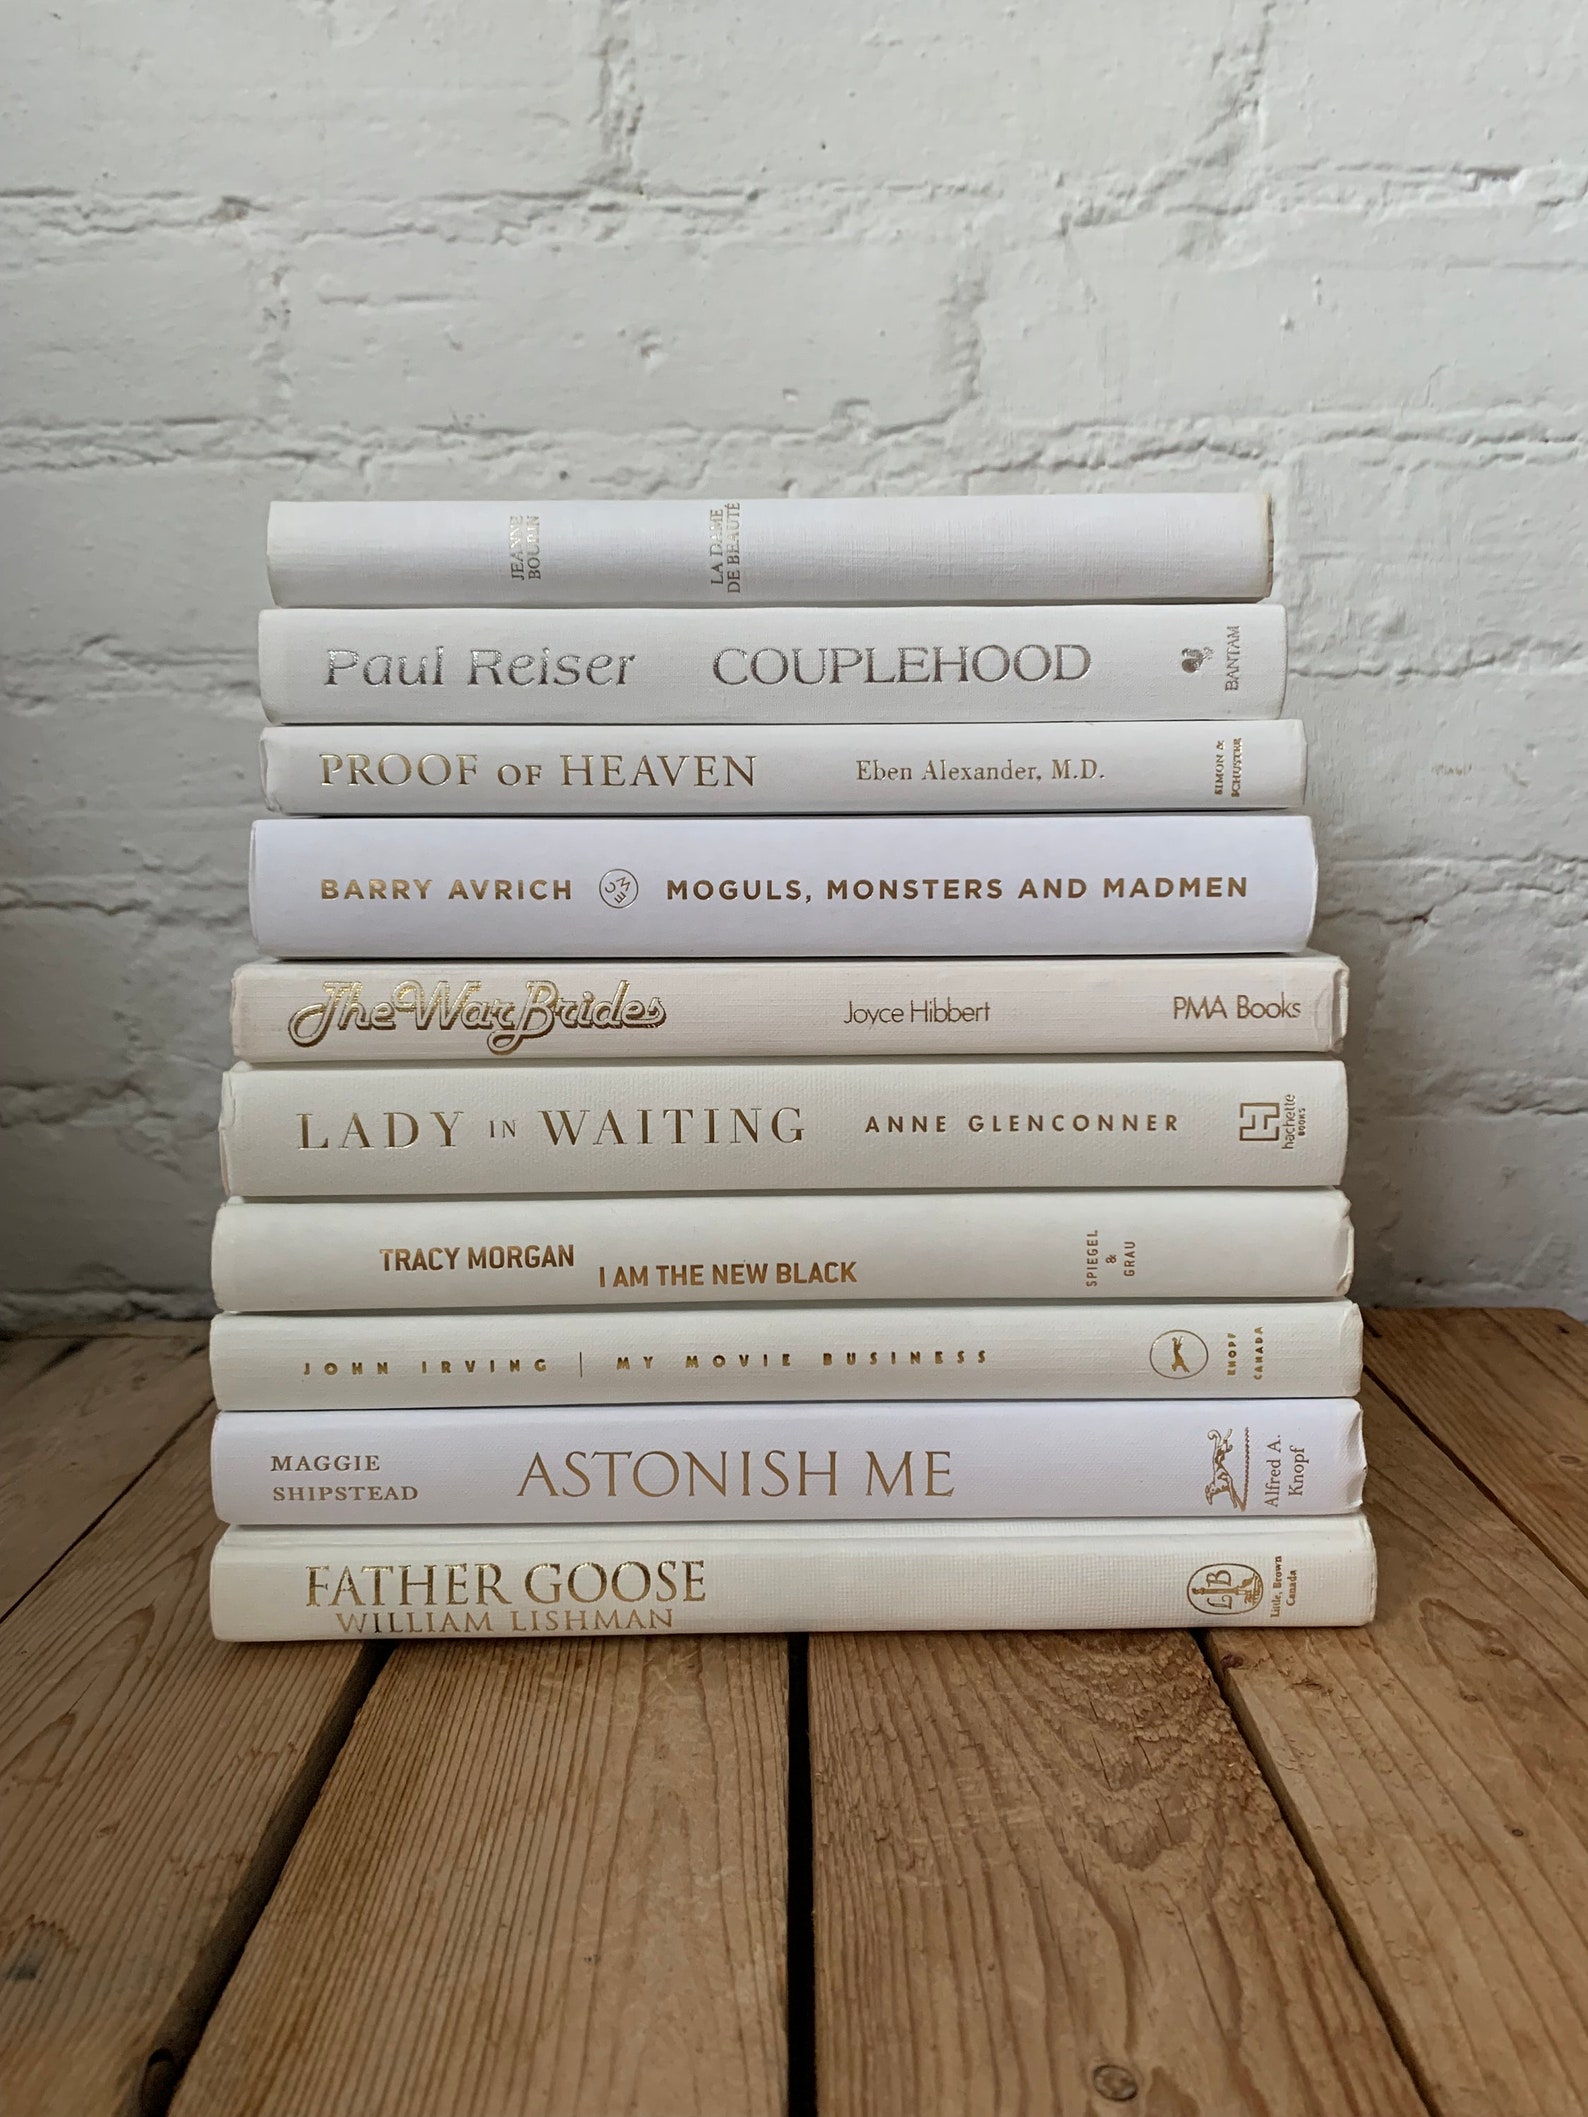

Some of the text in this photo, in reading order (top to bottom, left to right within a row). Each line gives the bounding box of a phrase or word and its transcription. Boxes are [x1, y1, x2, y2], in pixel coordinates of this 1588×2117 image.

[510, 514, 525, 581] JEANNE
[710, 508, 723, 585] LA DAME
[724, 502, 741, 593] DE BEAUTÉ
[324, 645, 637, 687] Paul Reiser
[713, 643, 1093, 686] COUPLEHOOD
[1225, 625, 1241, 691] BANTAM
[319, 753, 478, 787] PROOF
[560, 755, 756, 787] HEAVEN
[856, 758, 1105, 783] Eben Alexander, M.D.
[1214, 739, 1225, 797] SIMON &
[1231, 737, 1242, 798] SCHUSTER
[321, 879, 572, 901] BARRY AVRICH
[667, 876, 1248, 902] MOGULS, MONSTERS AND MADMEN
[288, 979, 667, 1056] The War Brides
[843, 996, 990, 1030] Joyce Hibbert
[1173, 992, 1301, 1020] PMA Books
[296, 1106, 806, 1150] LADY IN WAITING
[865, 1113, 1178, 1134] ANNE GLENCONNER
[1281, 1093, 1296, 1150] hachette
[1298, 1107, 1307, 1136] BOOKS
[380, 1244, 575, 1272] TRACY MORGAN
[600, 1261, 857, 1288] I AM THE NEW BLACK
[1086, 1229, 1098, 1287] SPIEGEL
[1106, 1253, 1116, 1264] &
[1124, 1240, 1136, 1277] GRAU
[304, 1359, 547, 1376] JOHN IRVING
[617, 1350, 986, 1370] MY MOVIE BUSINESS
[1227, 1332, 1237, 1376] KNOPF
[1254, 1326, 1263, 1380] CANADA
[271, 1454, 380, 1473] MAGGIE
[517, 1450, 955, 1498] ASTONISH ME
[1265, 1434, 1281, 1508] Alfred A.
[1288, 1445, 1309, 1497] Knopf
[273, 1485, 418, 1501] SHIPSTEAD
[307, 1559, 706, 1607] FATHER GOOSE
[1270, 1555, 1282, 1618] Little, Brown
[1286, 1570, 1297, 1606] Canada
[336, 1608, 674, 1634] WILLIAM LISHMAN
